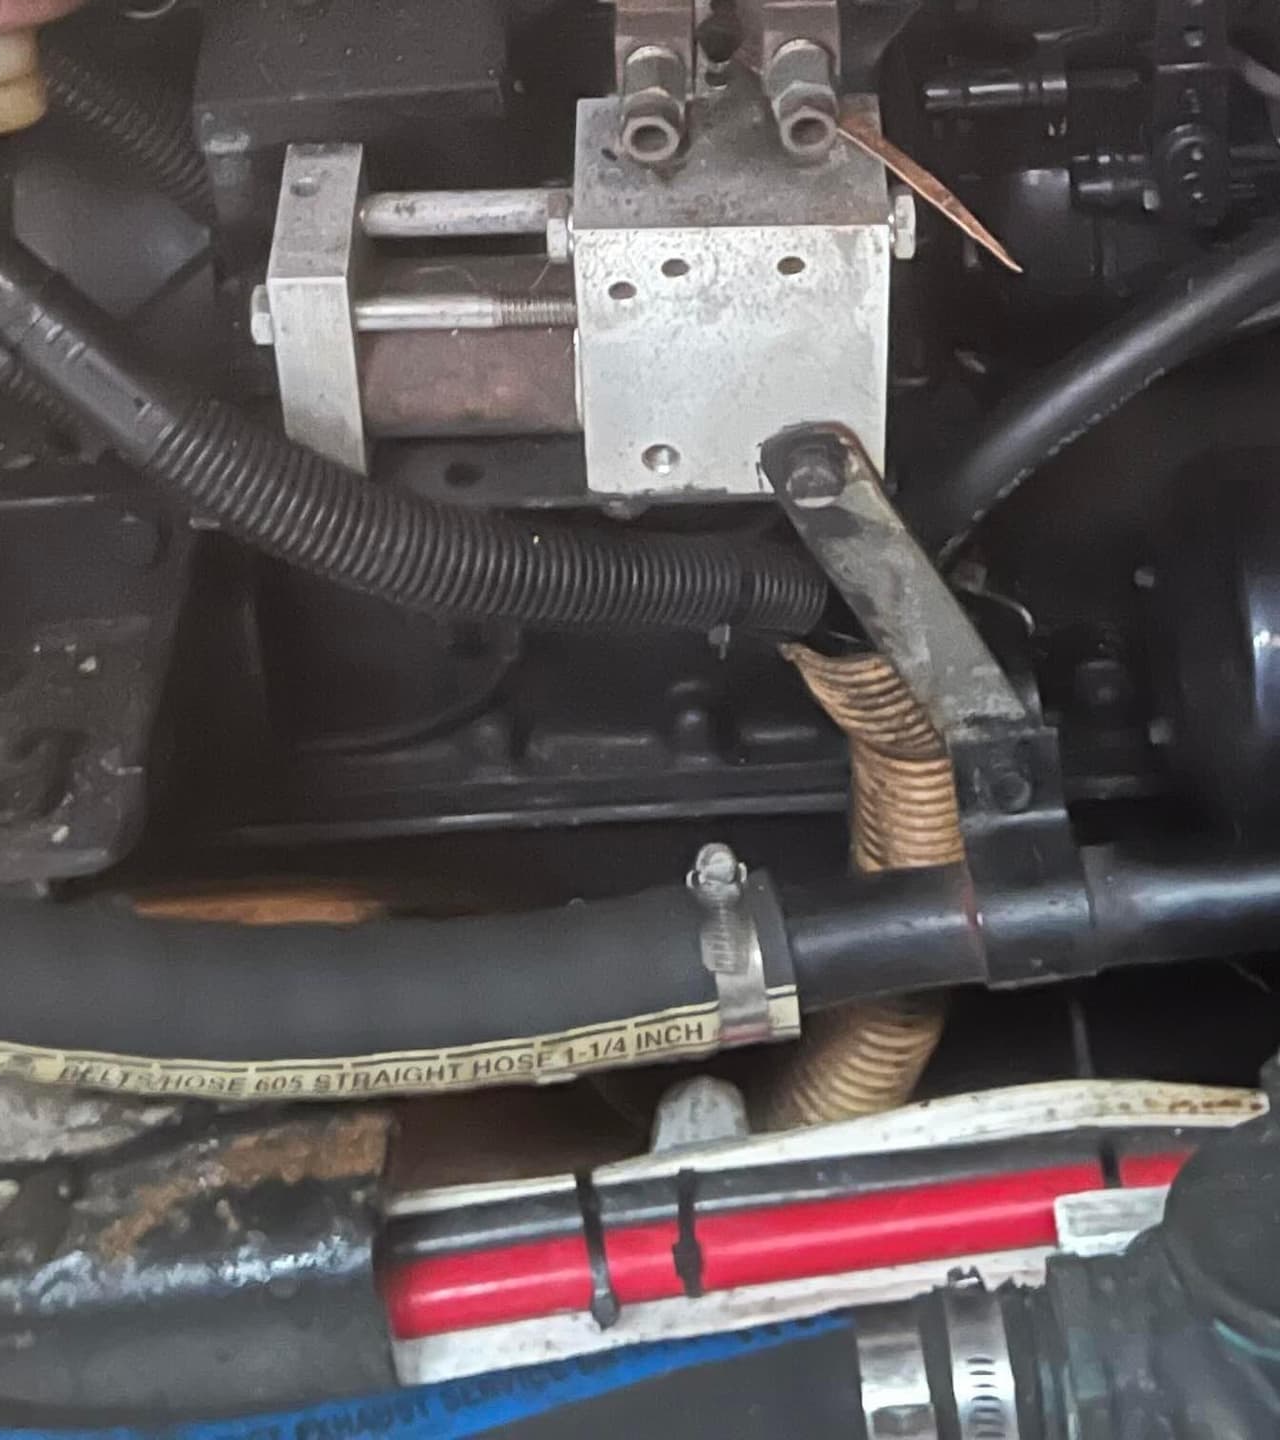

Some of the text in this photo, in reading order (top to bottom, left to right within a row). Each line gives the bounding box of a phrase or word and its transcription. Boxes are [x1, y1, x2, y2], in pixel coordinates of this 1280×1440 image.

[254, 1074, 303, 1093] 605
[315, 1062, 465, 1094] STRAIGHT
[473, 1050, 553, 1076] HOSE
[565, 1037, 625, 1064] 1-1/4
[635, 1021, 703, 1052] INCH
